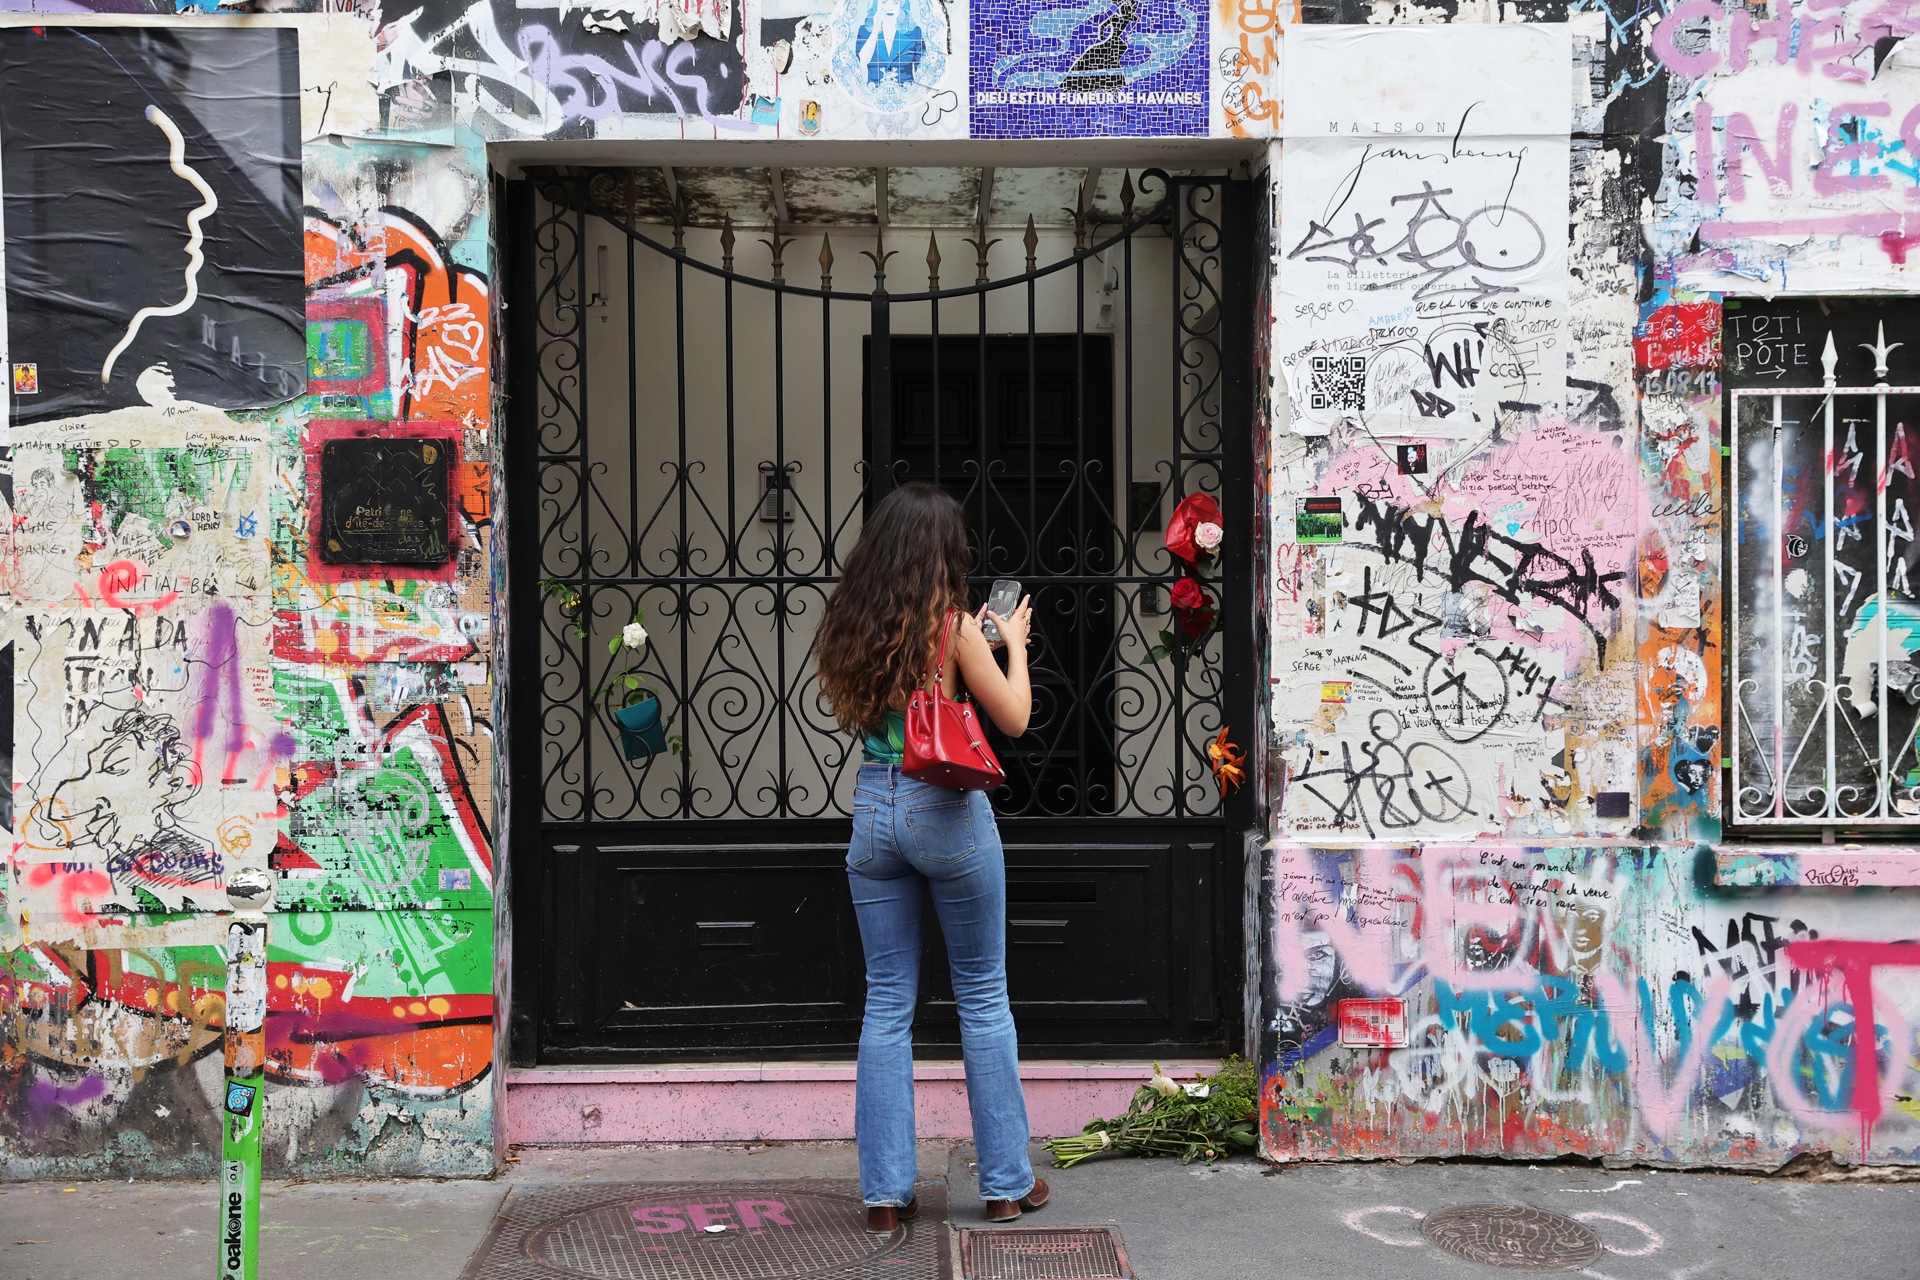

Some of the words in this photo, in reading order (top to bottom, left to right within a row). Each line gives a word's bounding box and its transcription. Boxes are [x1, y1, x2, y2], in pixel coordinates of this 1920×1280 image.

[976, 91, 1008, 105] DIEU
[1009, 91, 1035, 105] EST
[1036, 91, 1056, 105] UN
[1059, 91, 1118, 105] FUMEUR
[1118, 91, 1134, 105] DE
[1140, 91, 1202, 105] HAVANES
[1329, 121, 1446, 133] MAISON
[1327, 270, 1340, 279] La
[1346, 270, 1419, 279] billetterie
[1411, 283, 1457, 291] ouverte
[1736, 342, 1809, 366] POTE
[192, 511, 211, 522] LORD
[197, 521, 221, 532] HENRY
[1292, 661, 1321, 672] SERGE
[631, 1199, 798, 1234] SER
